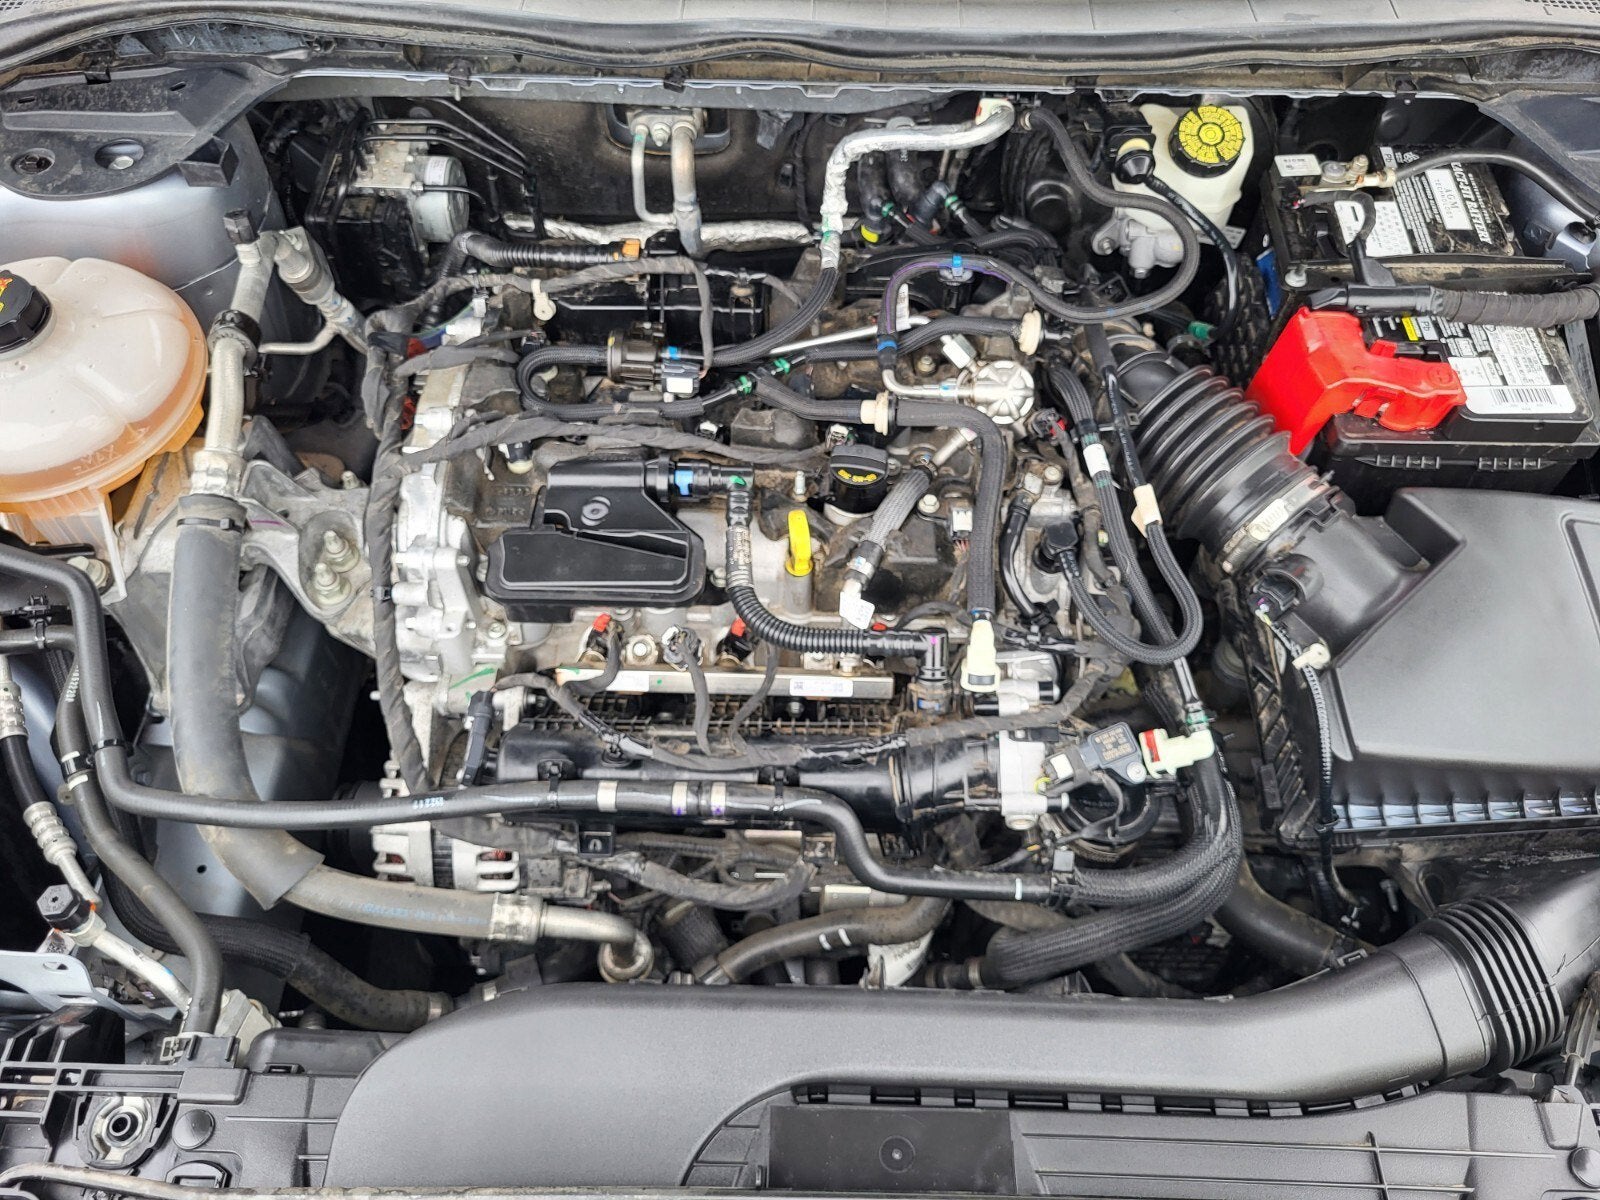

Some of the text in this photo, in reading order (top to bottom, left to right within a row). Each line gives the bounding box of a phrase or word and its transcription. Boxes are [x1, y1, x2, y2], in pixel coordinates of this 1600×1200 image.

[1445, 188, 1460, 209] AGM
[1466, 200, 1492, 244] BATTERY
[1421, 321, 1432, 332] Pb
